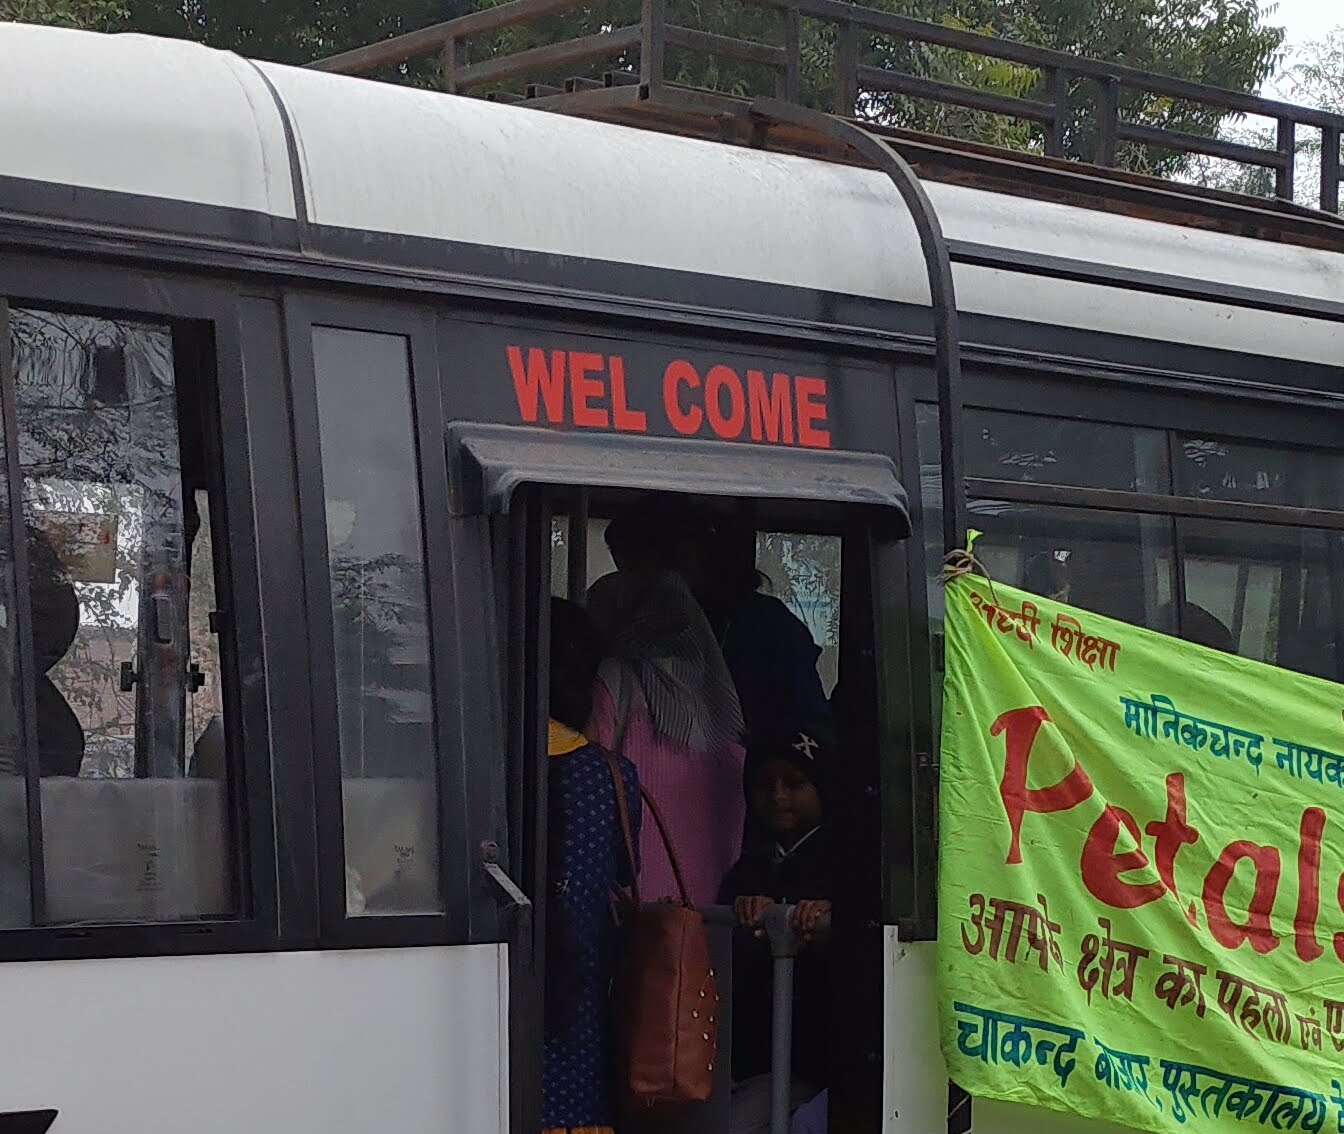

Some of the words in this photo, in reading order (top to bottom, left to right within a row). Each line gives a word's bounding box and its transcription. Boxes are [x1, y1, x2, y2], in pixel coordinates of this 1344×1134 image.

[662, 360, 832, 449] COME
[1155, 954, 1207, 1018] का
[954, 1001, 1085, 1088] चाकन्द
